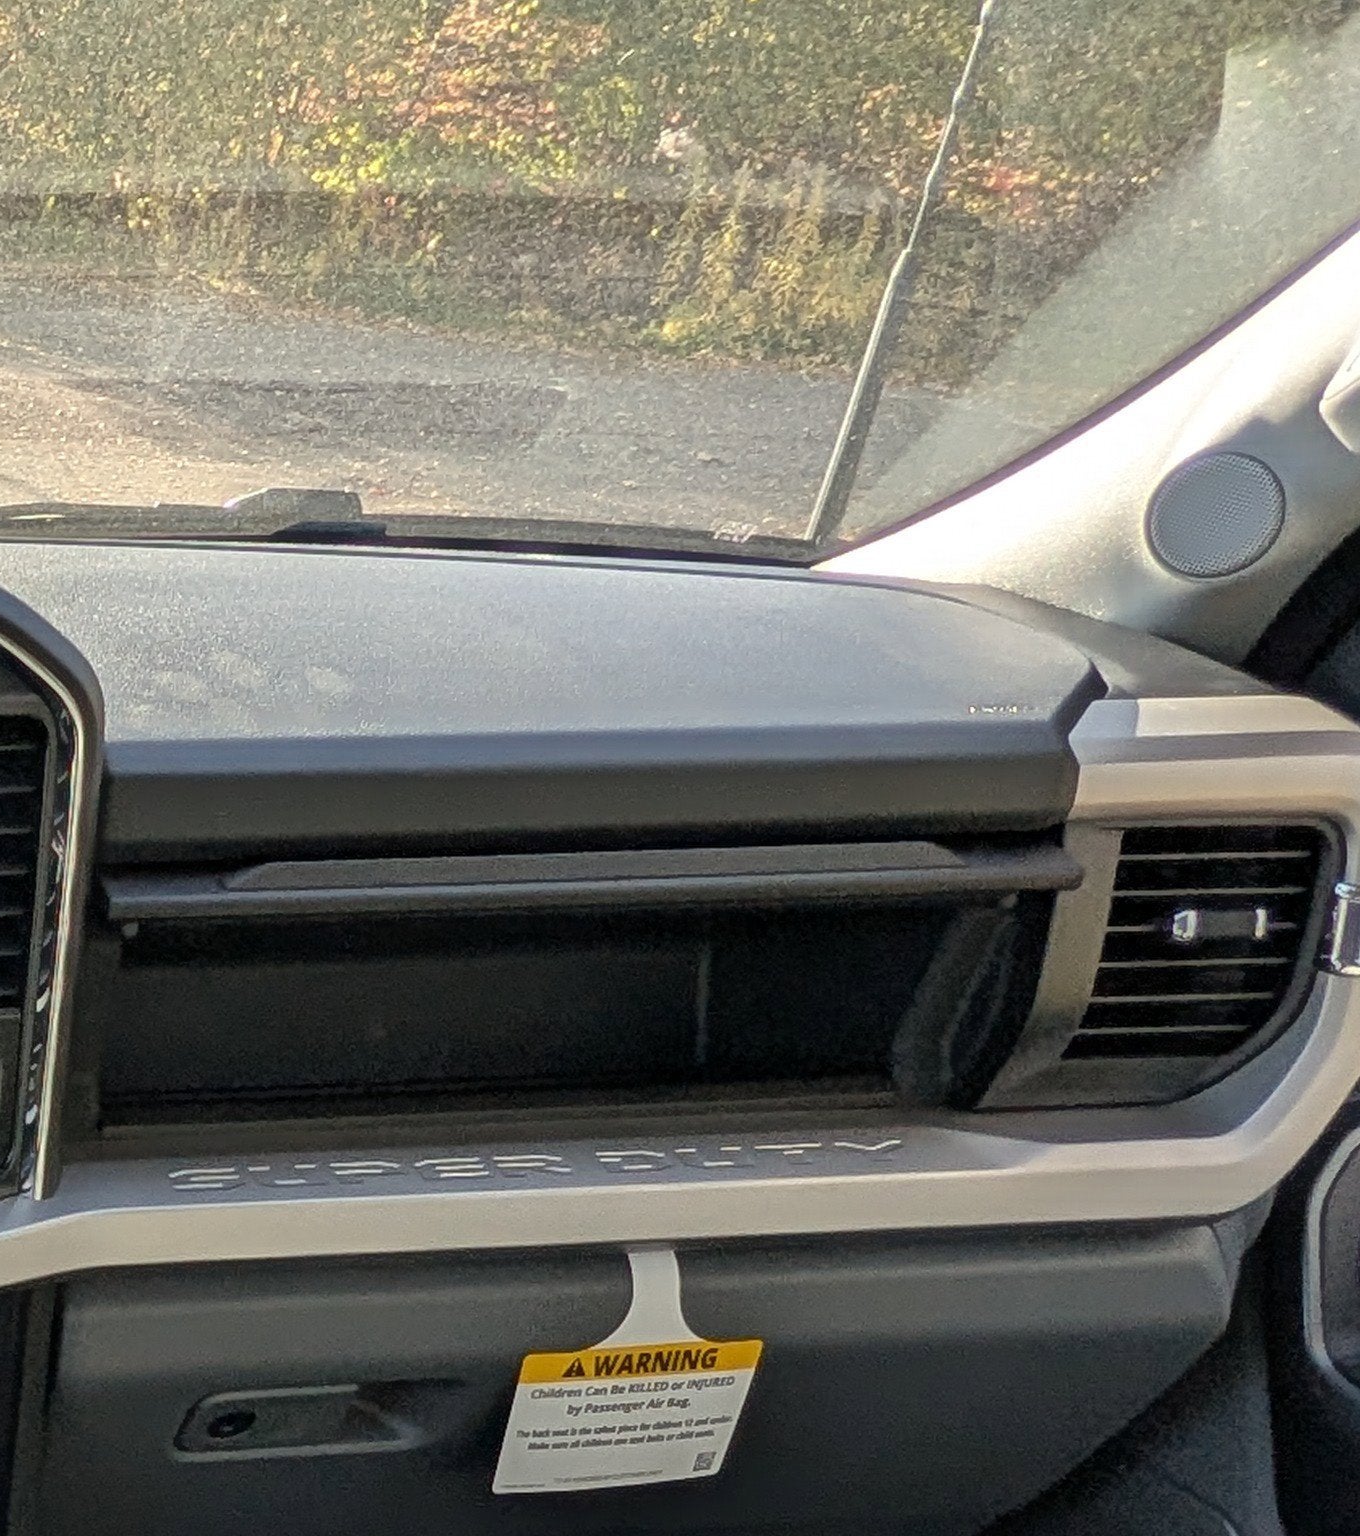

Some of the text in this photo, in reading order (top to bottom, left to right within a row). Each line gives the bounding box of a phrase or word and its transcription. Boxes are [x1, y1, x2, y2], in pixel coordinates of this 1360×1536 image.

[169, 1154, 573, 1190] SUPER
[592, 1348, 719, 1377] WARNING
[531, 1376, 735, 1400] Children Can Be KILLED or INJURED
[566, 1402, 581, 1416] by
[584, 1400, 645, 1416] Passenger
[646, 1398, 665, 1409] Air
